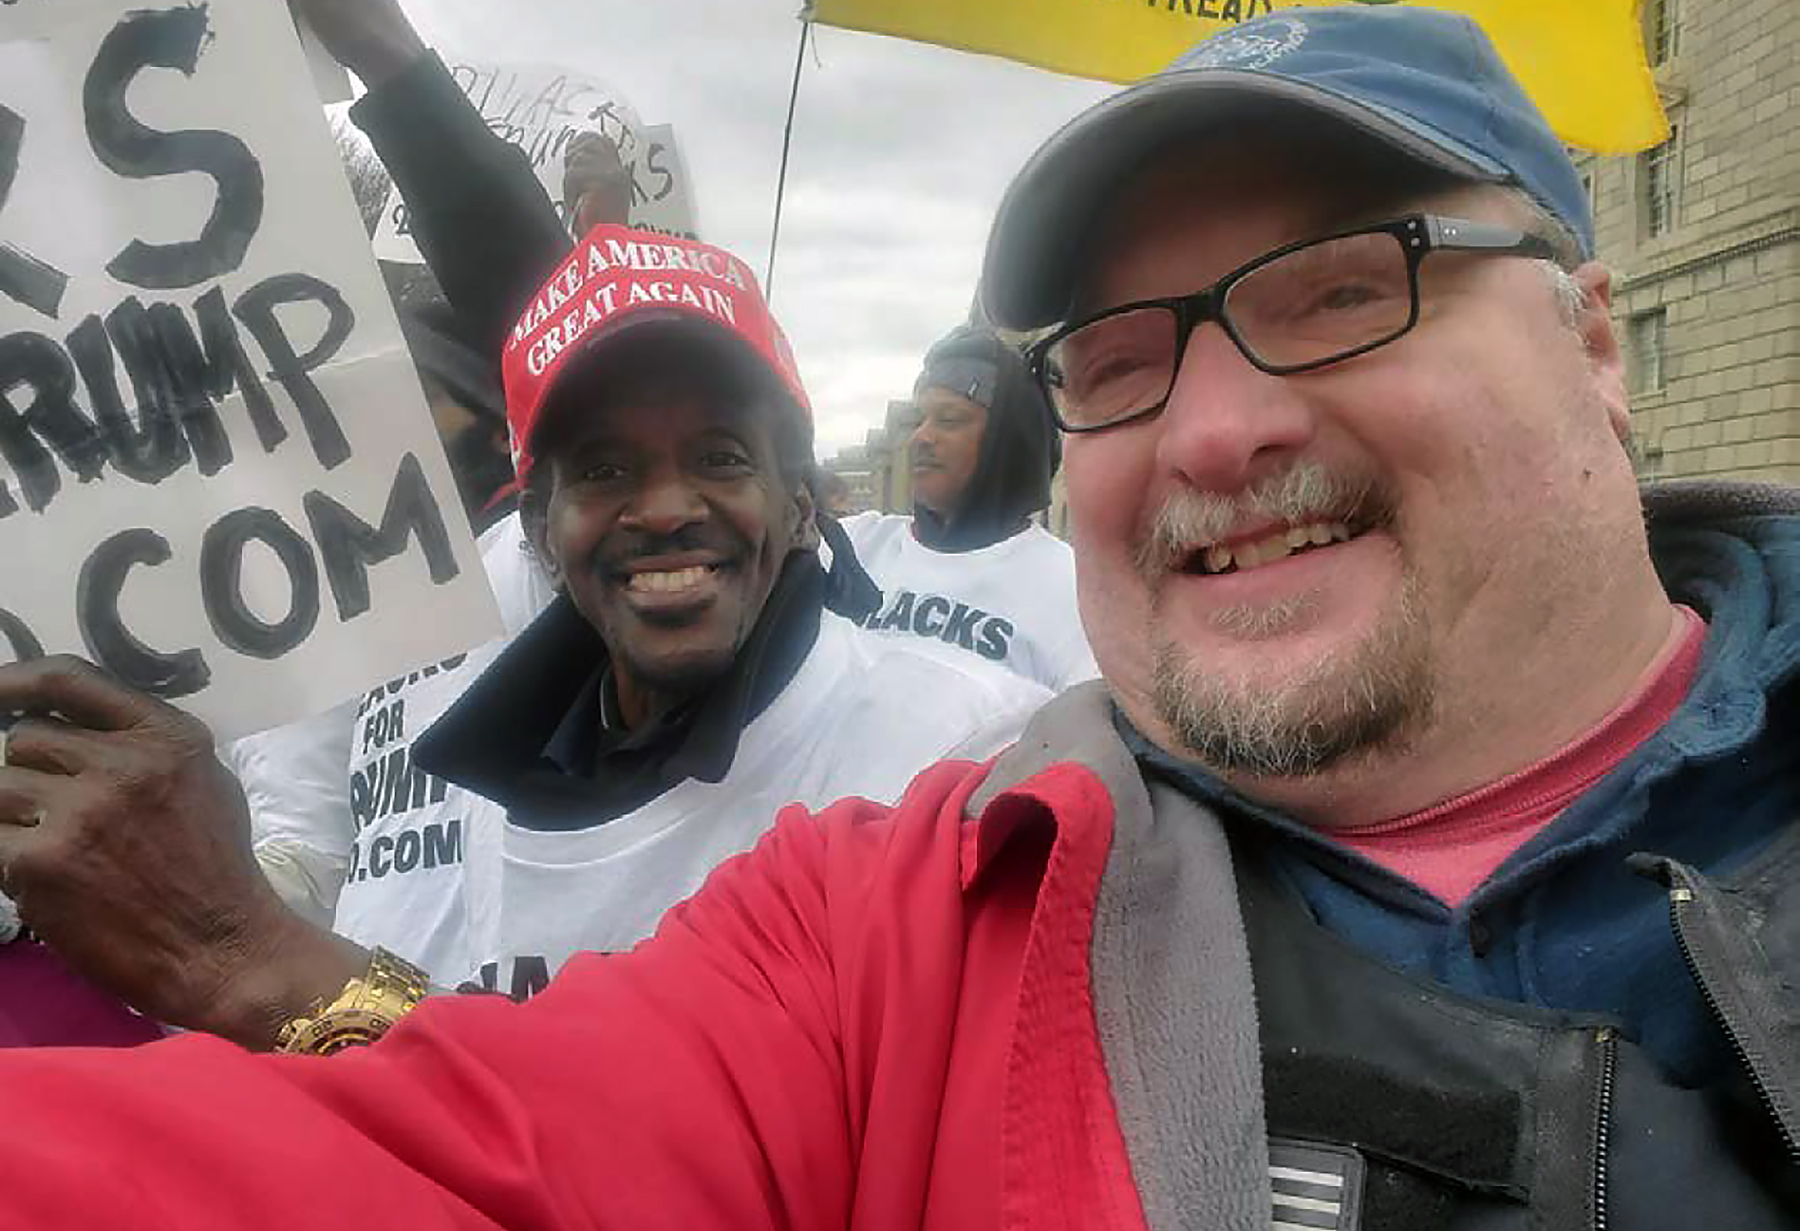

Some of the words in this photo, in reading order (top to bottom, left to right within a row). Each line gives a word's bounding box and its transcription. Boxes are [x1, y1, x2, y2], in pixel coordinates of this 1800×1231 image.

[510, 260, 583, 350] MAKE
[586, 239, 749, 291] AMERICA
[527, 283, 618, 376] GREAT
[628, 281, 737, 325] AGAIN
[0, 273, 355, 518] RUMP
[363, 698, 404, 755] FOR
